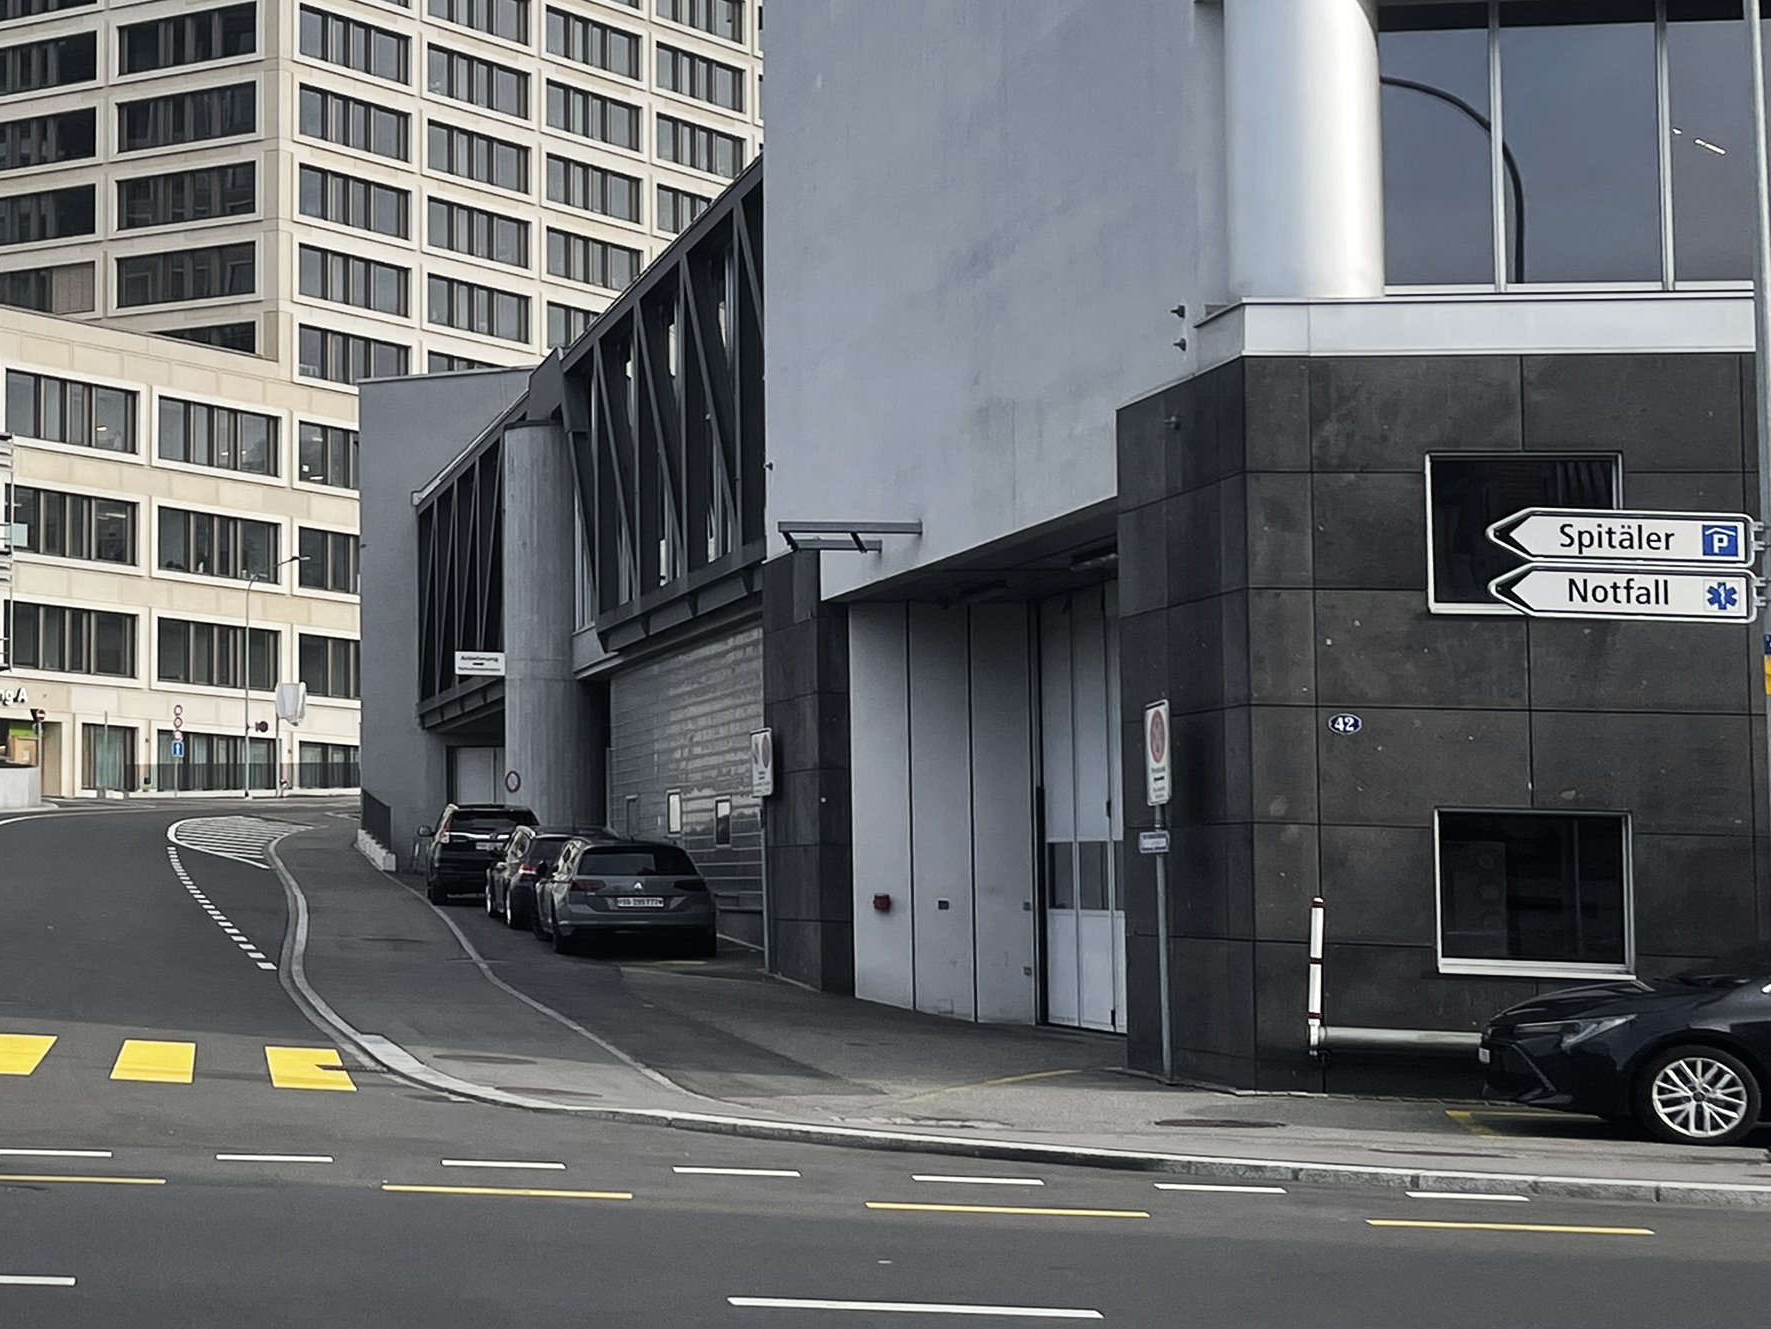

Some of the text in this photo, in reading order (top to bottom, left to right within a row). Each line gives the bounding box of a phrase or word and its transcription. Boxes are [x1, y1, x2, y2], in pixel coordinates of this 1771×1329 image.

[1559, 523, 1729, 555] Spitäler P
[1568, 578, 1669, 605] Notfall
[17, 686, 29, 703] A
[1334, 717, 1355, 731] 42
